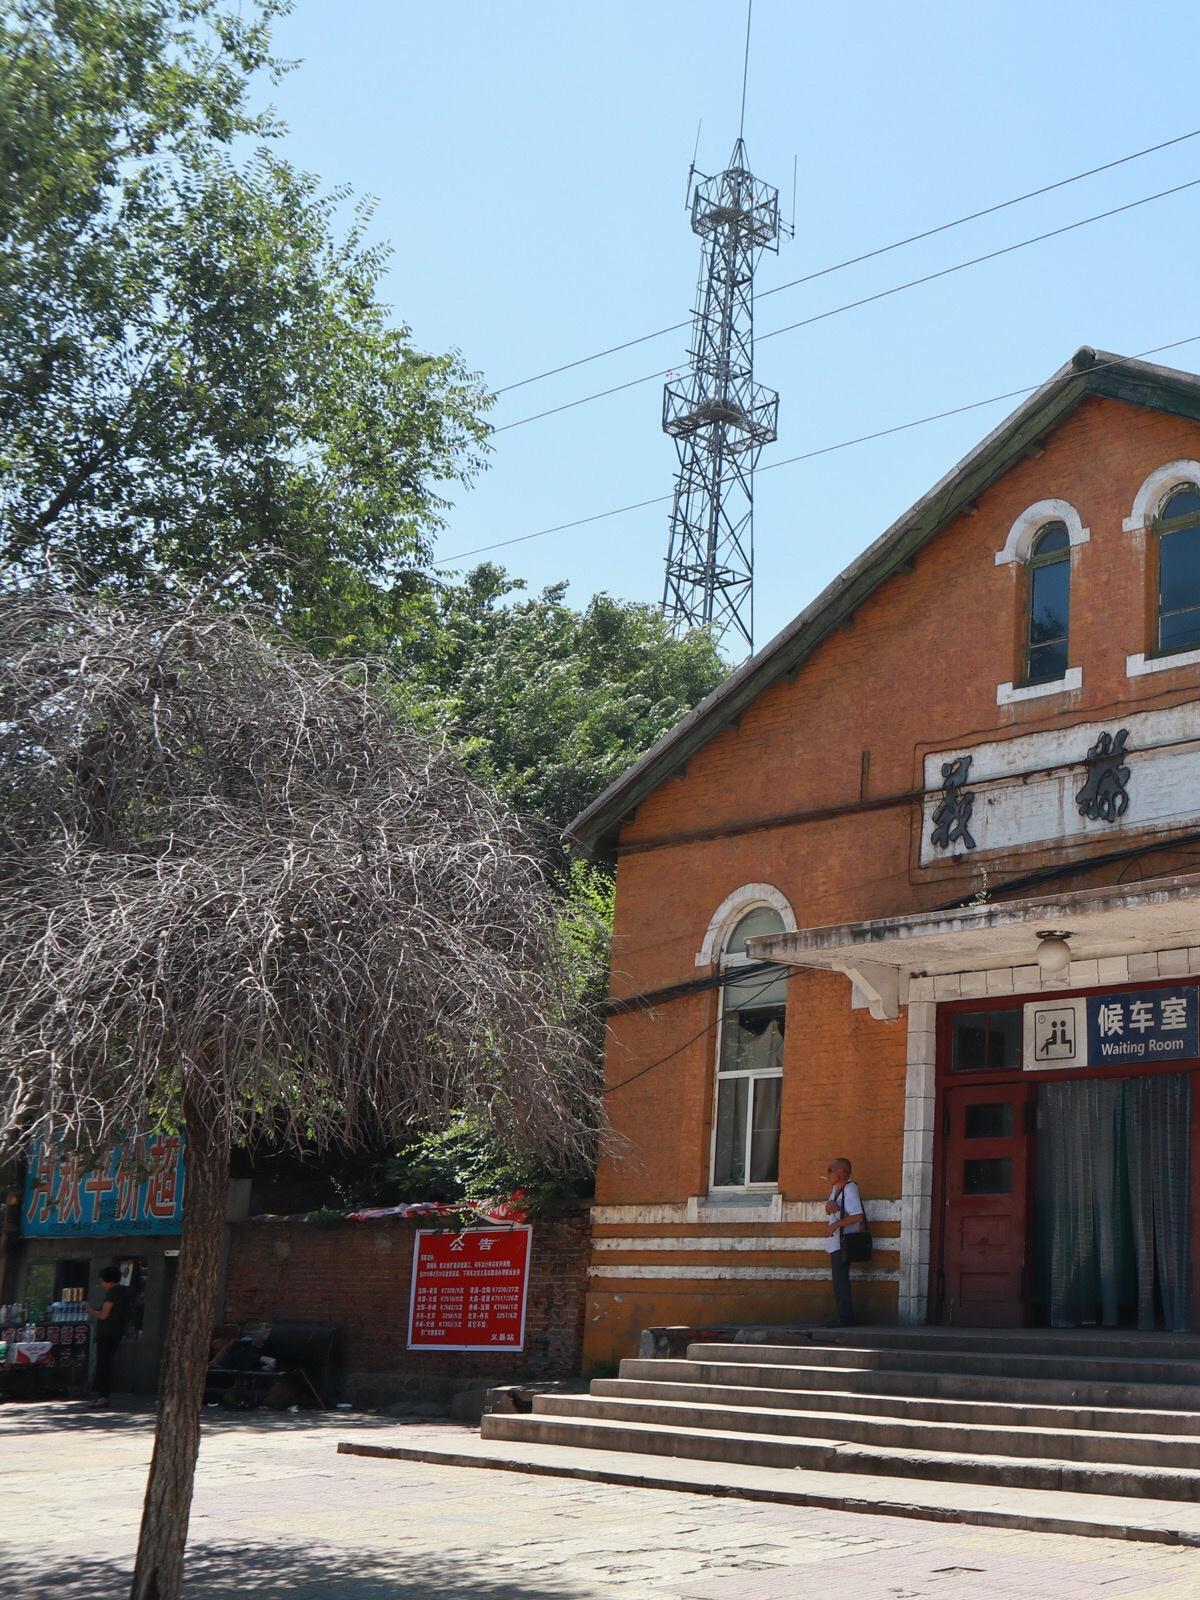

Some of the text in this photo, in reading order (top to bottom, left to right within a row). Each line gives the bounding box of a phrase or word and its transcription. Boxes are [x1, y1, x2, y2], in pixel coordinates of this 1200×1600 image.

[1098, 997, 1187, 1037] 候车室
[1102, 1038, 1184, 1056] Waiting Room
[449, 1238, 494, 1251] 公告
[490, 1333, 515, 1341] 义县站
